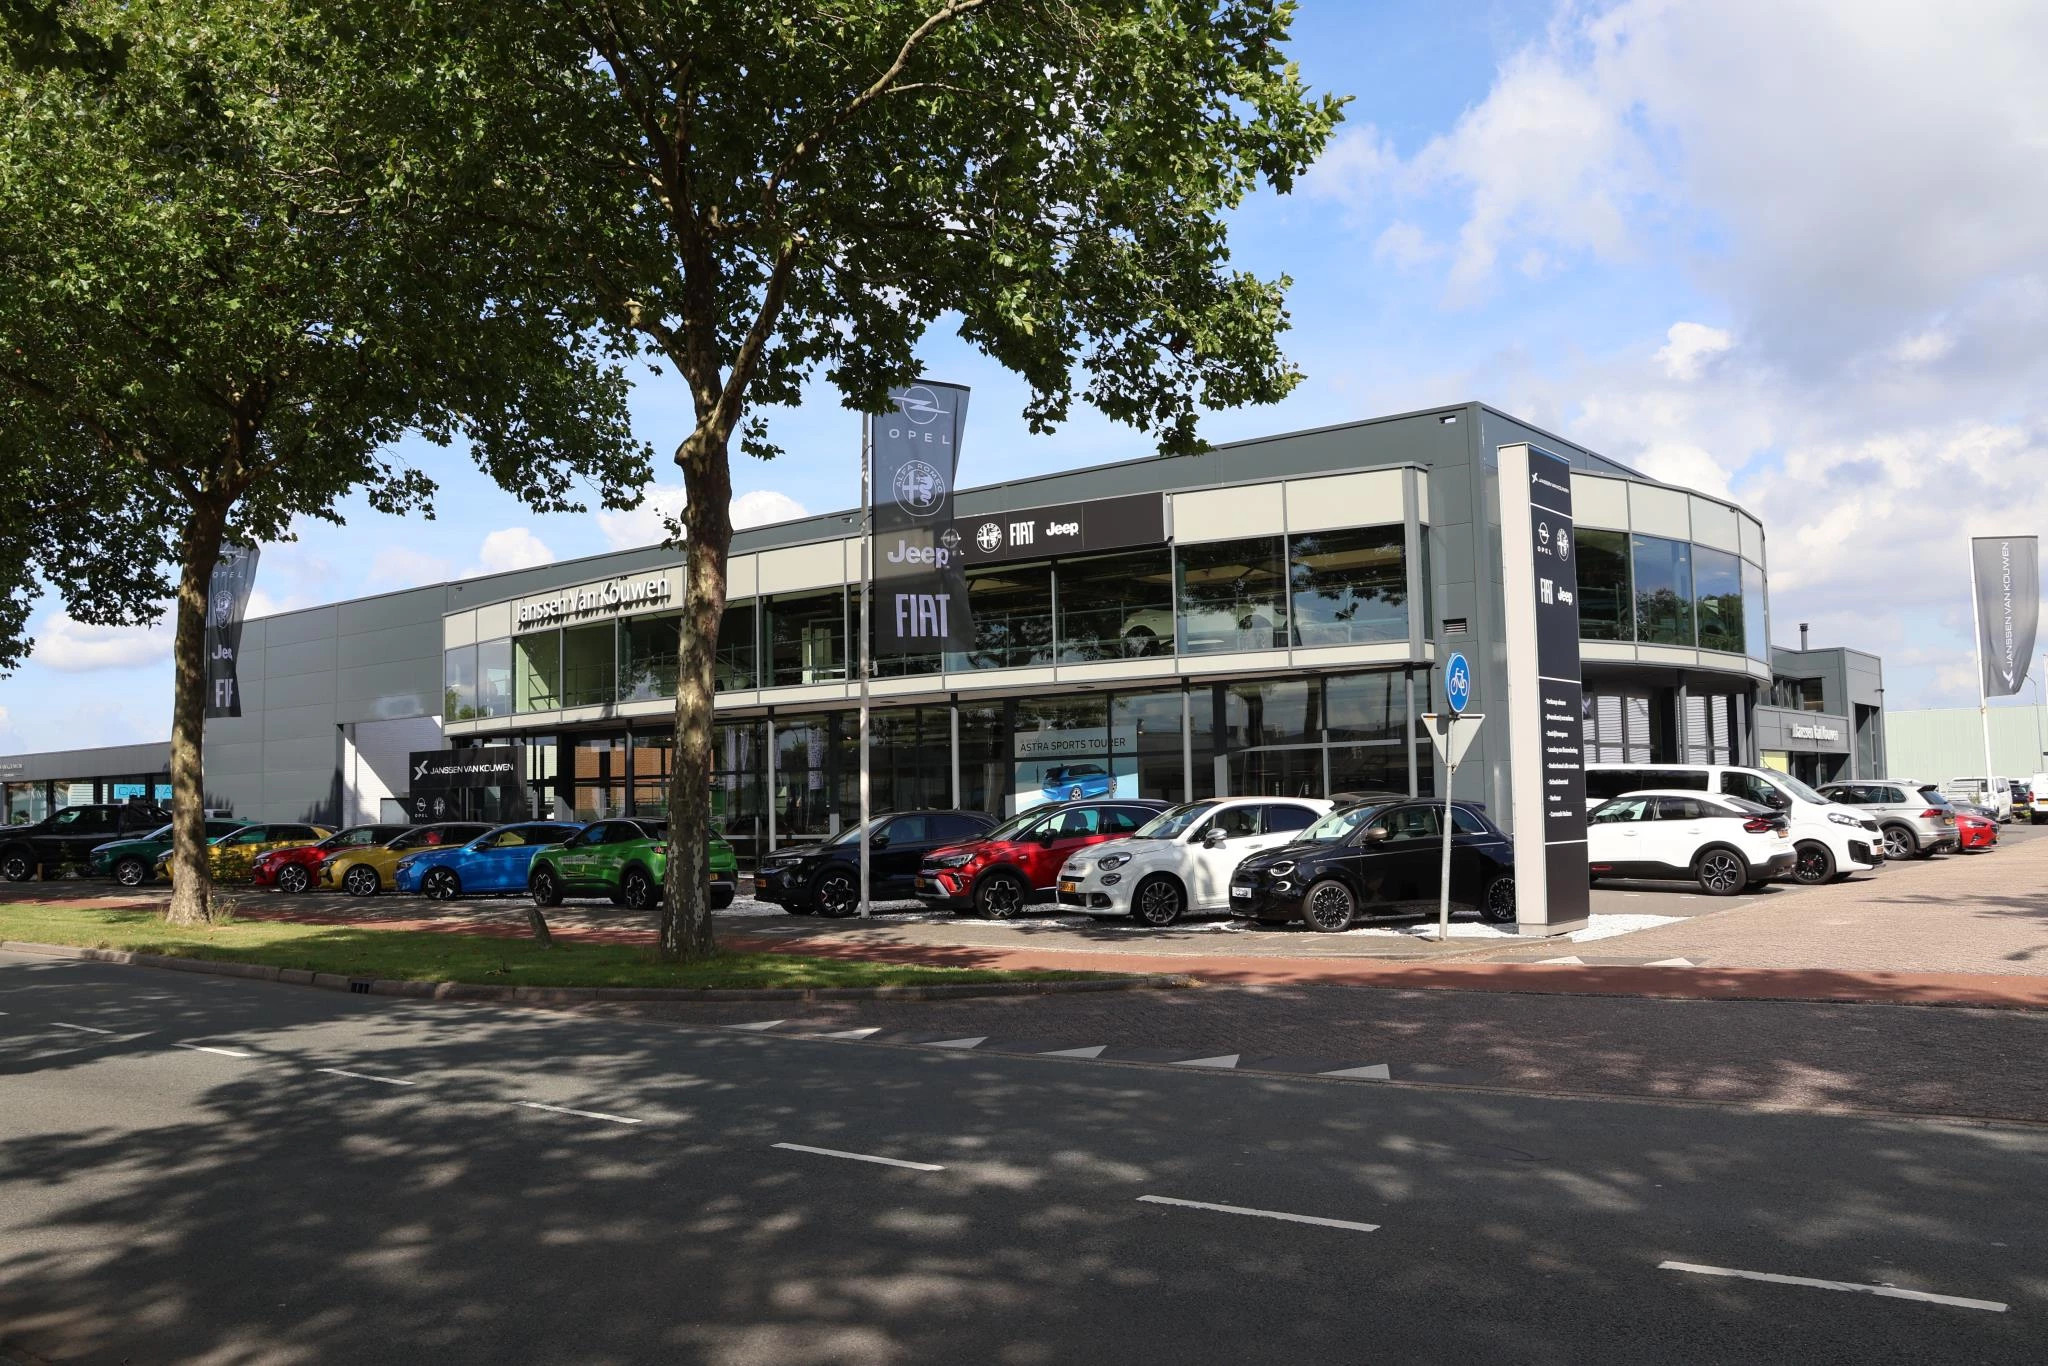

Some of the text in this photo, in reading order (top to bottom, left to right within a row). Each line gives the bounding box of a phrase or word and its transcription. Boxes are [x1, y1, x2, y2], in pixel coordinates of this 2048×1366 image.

[888, 428, 951, 445] OPEL
[896, 463, 943, 493] ALFA ROMEO
[1009, 521, 1035, 546] FIAT
[1045, 521, 1079, 536] Jeep
[887, 540, 949, 568] Jeep
[212, 571, 243, 579] OPEL
[516, 577, 669, 623] Janssen Van Kouwen
[1540, 577, 1553, 605] FIAT
[1557, 586, 1573, 606] Jeep
[895, 593, 951, 637] FIAT
[2001, 541, 2013, 668] JANSSEN VAN KOUWEN
[1020, 741, 1049, 752] ASTRA
[1050, 739, 1086, 750] SPORTS
[430, 766, 463, 775] JANSSEN
[463, 764, 479, 773] VAN
